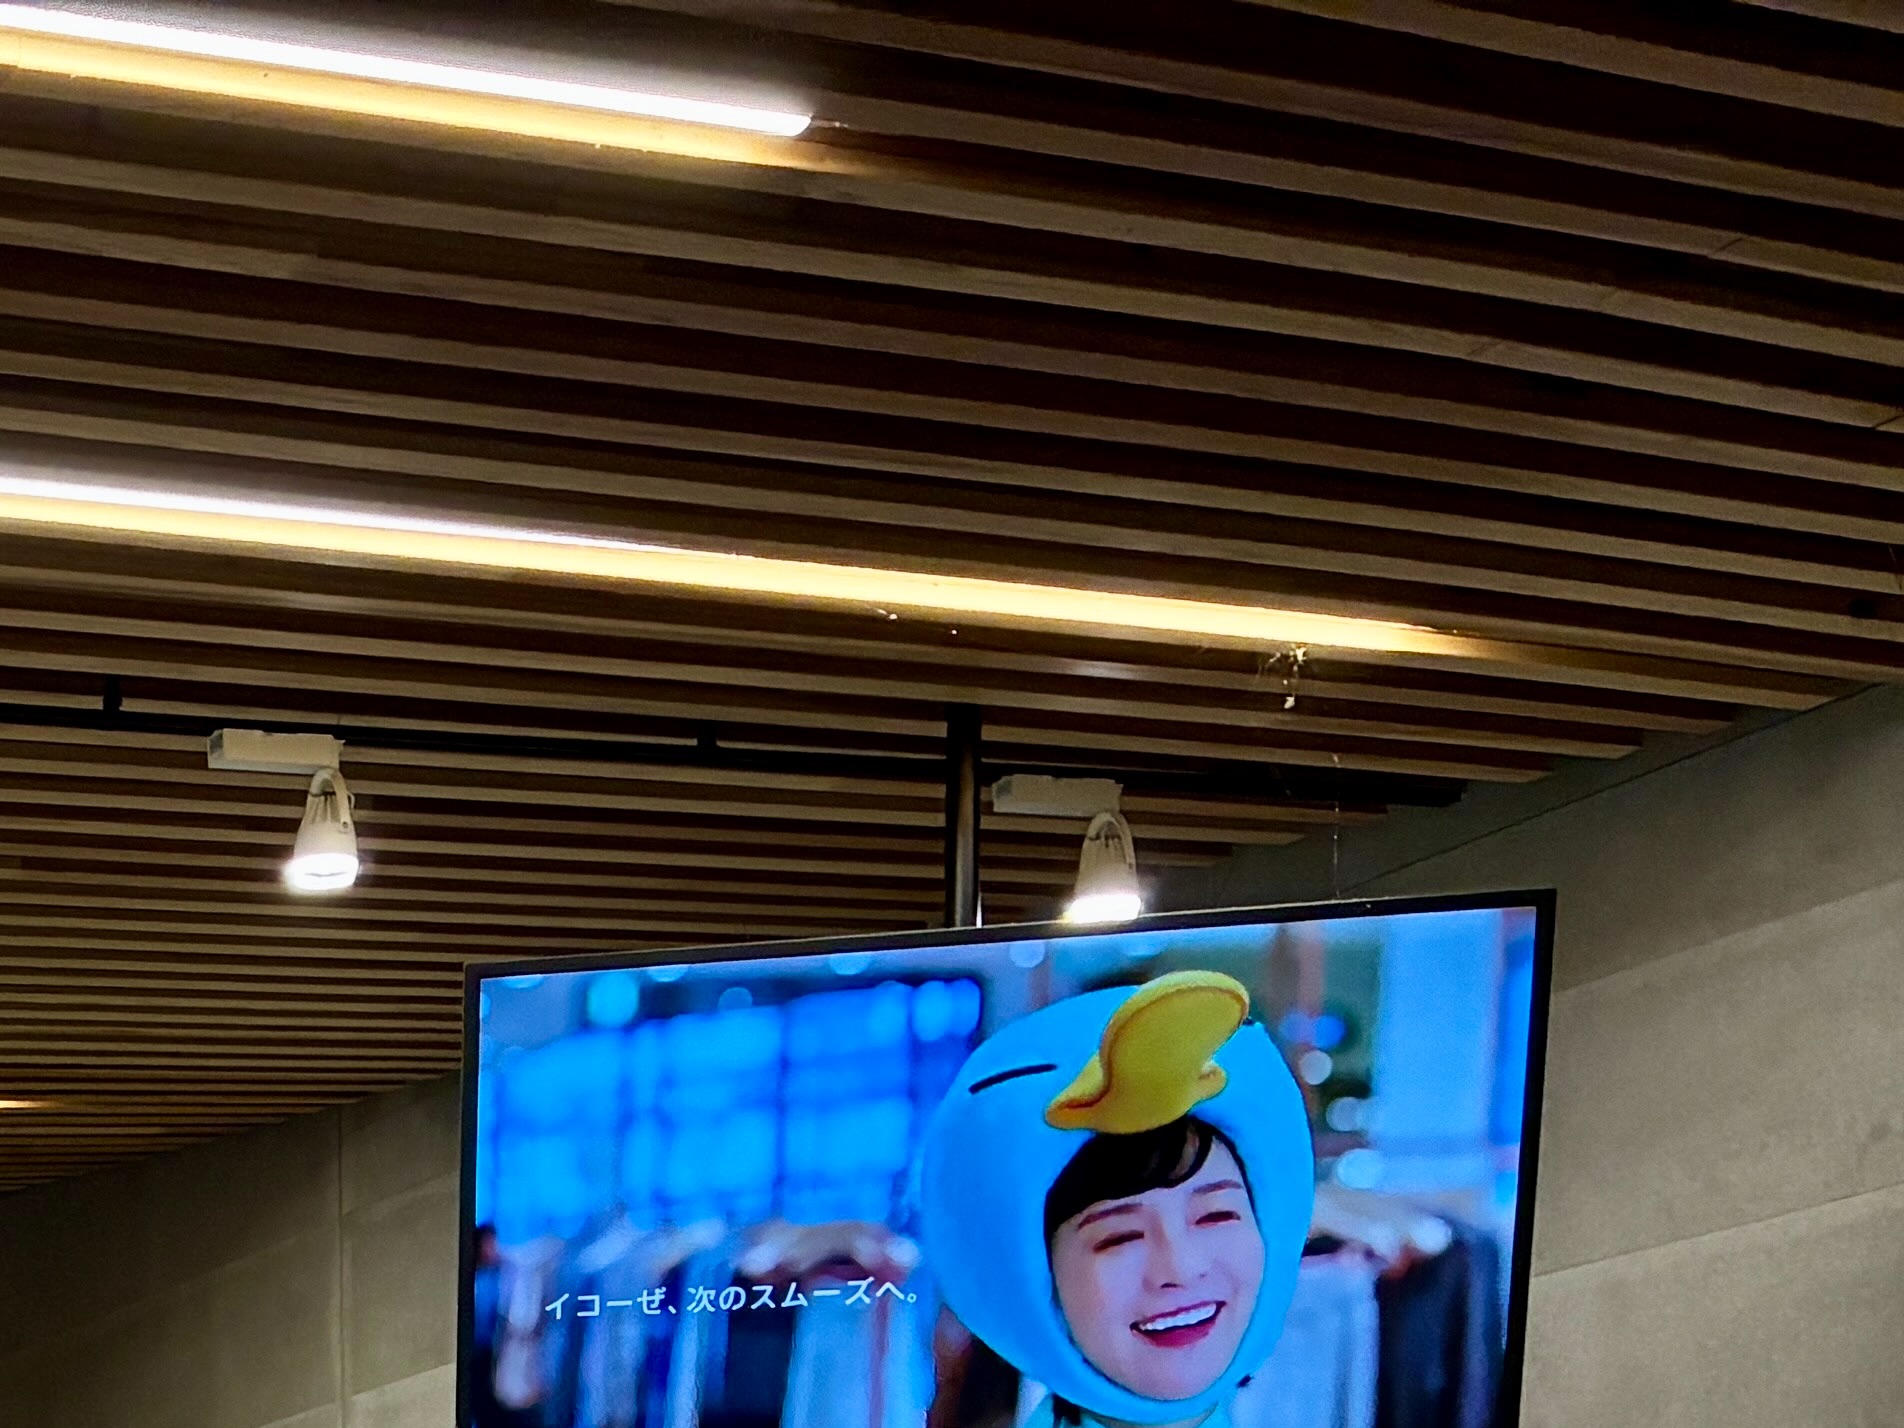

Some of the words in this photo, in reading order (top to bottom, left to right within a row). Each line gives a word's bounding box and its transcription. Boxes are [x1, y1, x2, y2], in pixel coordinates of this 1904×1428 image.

[545, 1275, 919, 1321] イコーぜ、次のスムーズへ。
